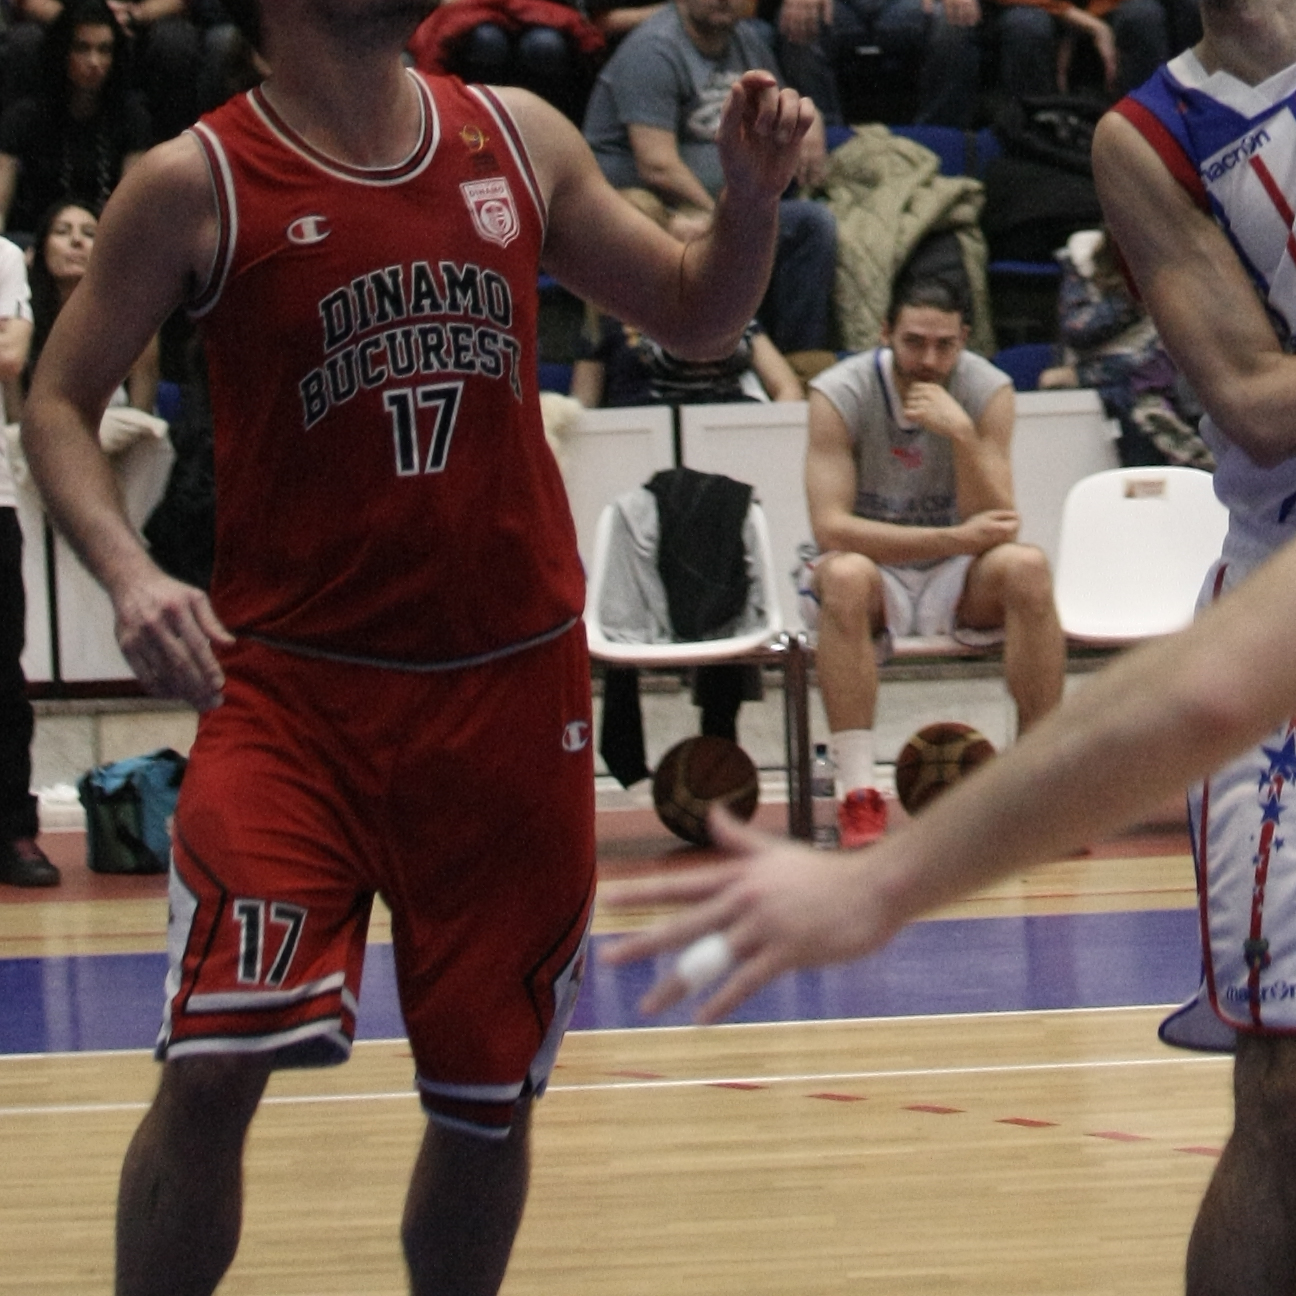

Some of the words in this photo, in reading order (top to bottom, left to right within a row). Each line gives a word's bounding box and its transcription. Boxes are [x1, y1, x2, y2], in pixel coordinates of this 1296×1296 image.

[319, 261, 513, 354] DINAMO
[382, 381, 464, 477] 17
[233, 898, 308, 987] 17
